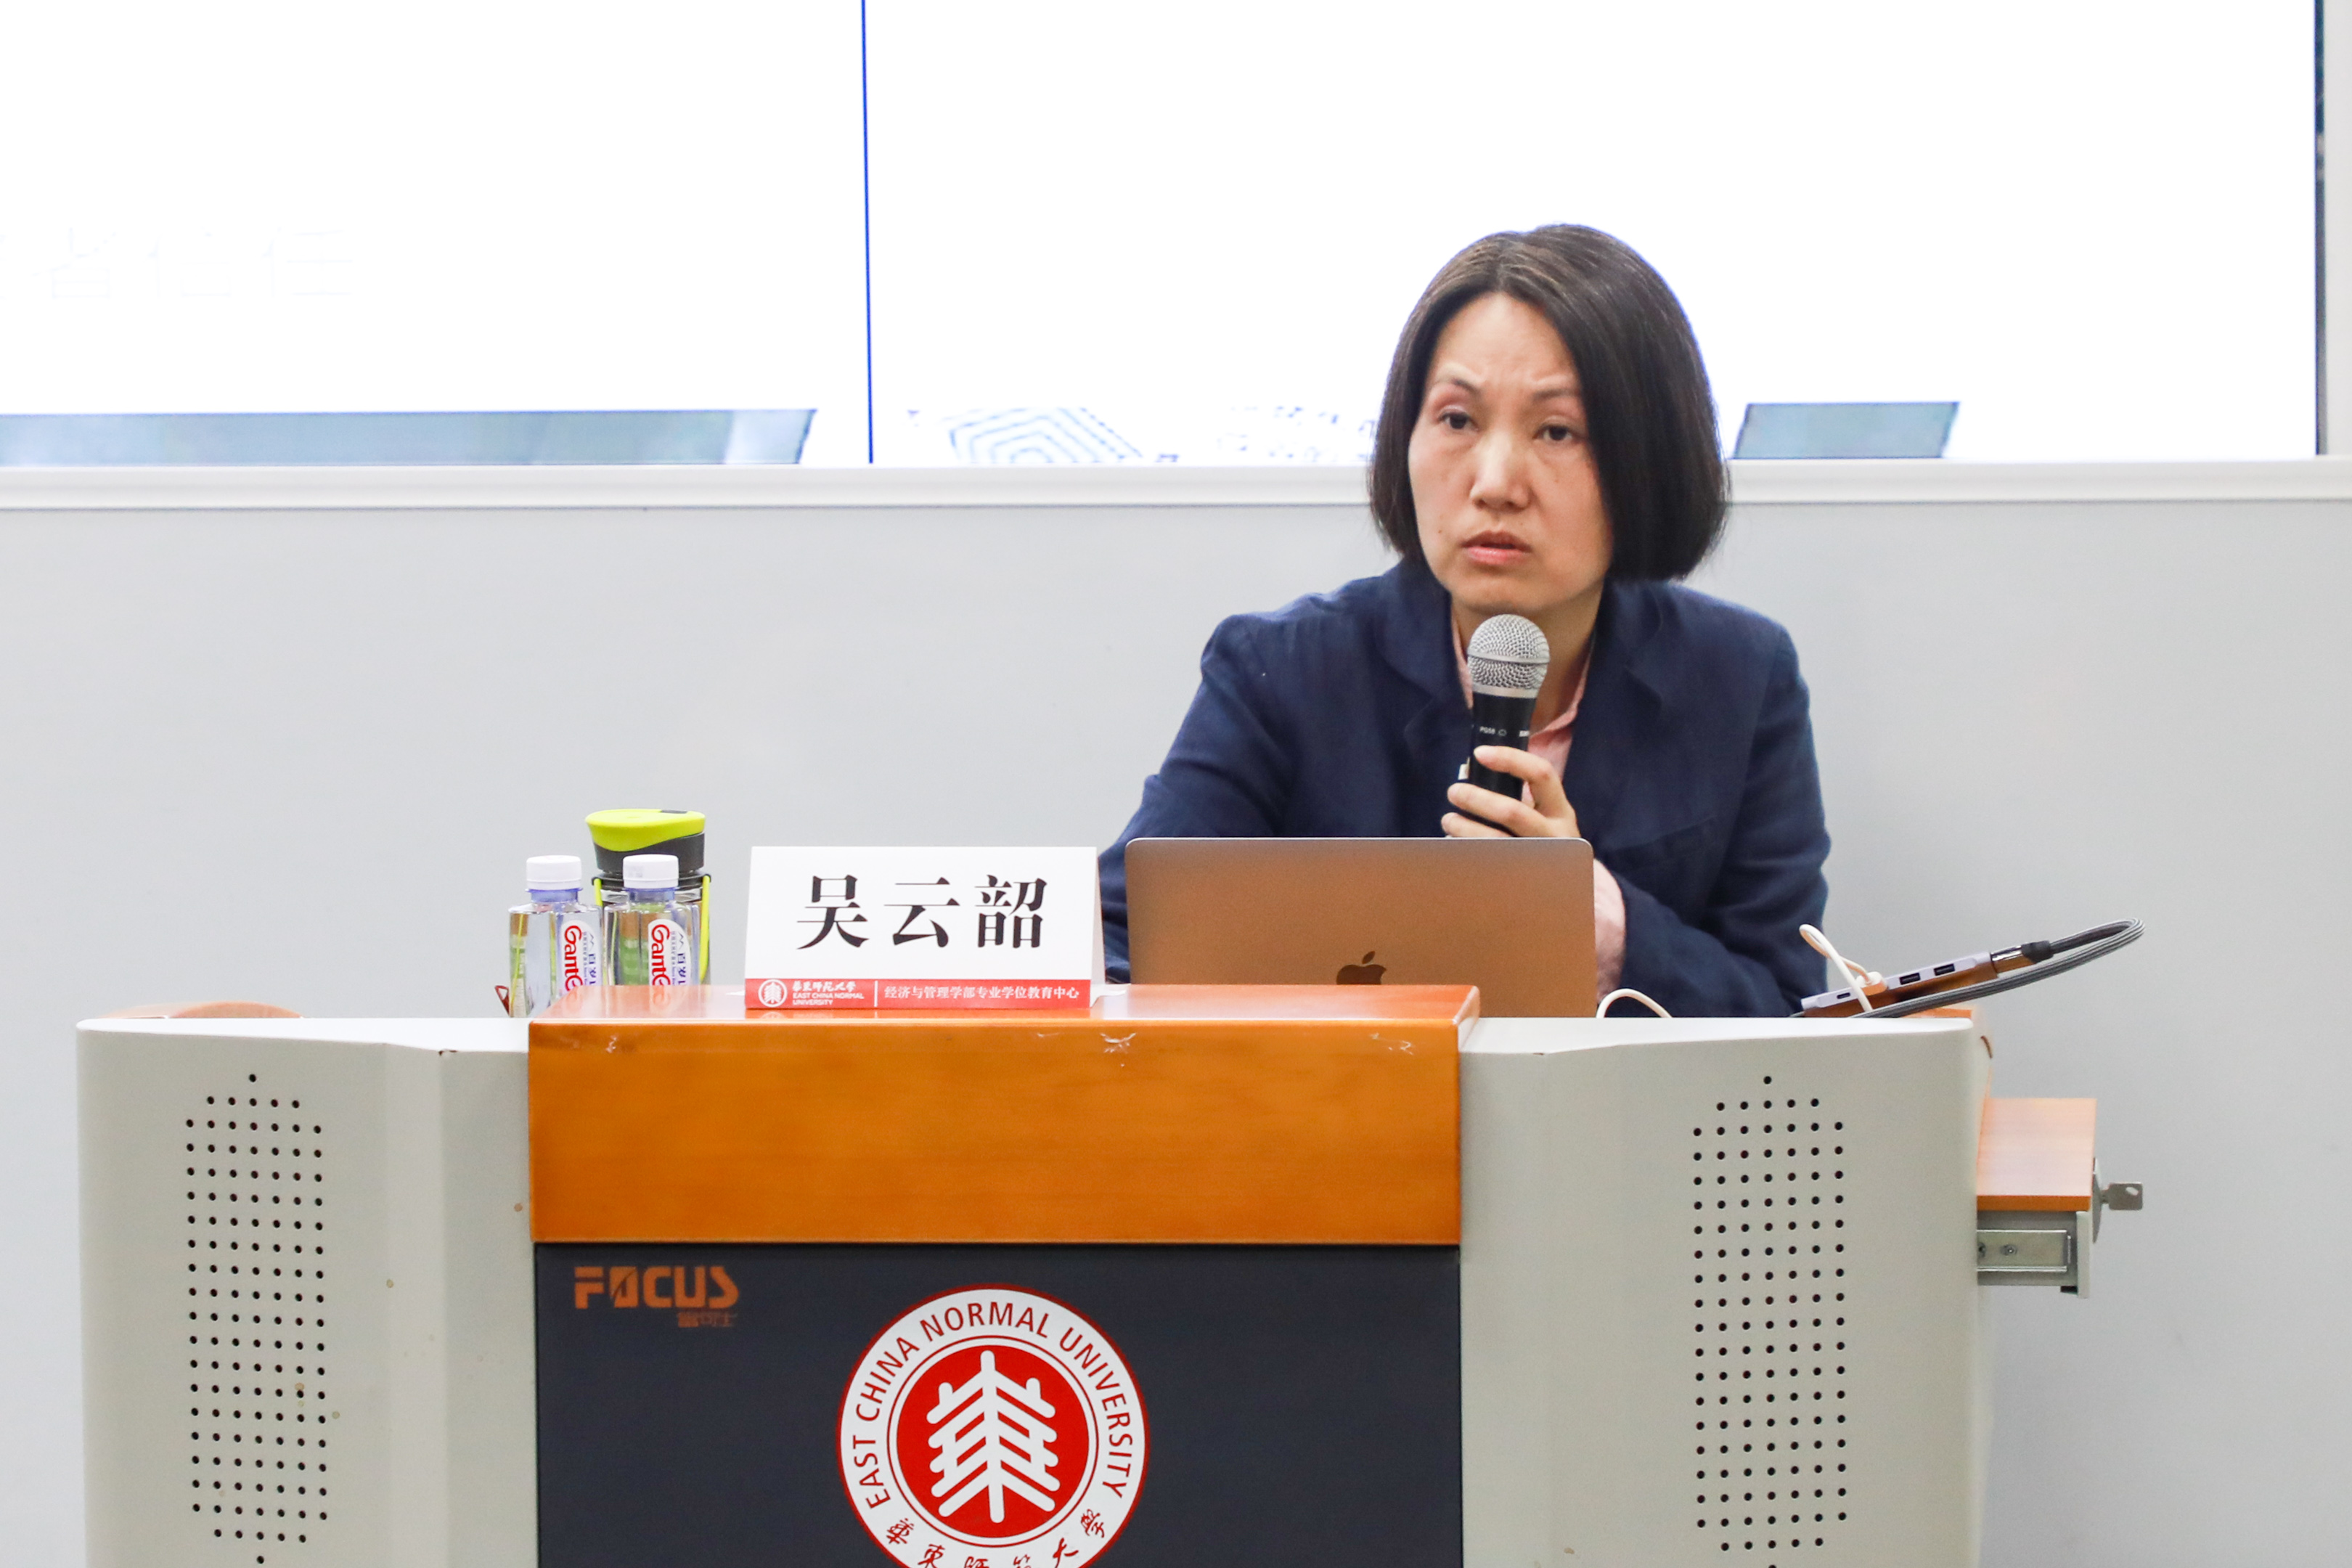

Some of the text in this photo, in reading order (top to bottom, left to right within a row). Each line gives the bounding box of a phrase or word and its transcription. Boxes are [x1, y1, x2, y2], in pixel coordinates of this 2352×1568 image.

[0, 226, 354, 300] 者信任
[796, 874, 1048, 950] 吴云韶
[883, 985, 1080, 1000] 经济与管理学部专业学位教育中心
[574, 1265, 740, 1310] FOCUS
[852, 1301, 1134, 1509] EAST CHINA NORMAL UNIVERSITY
